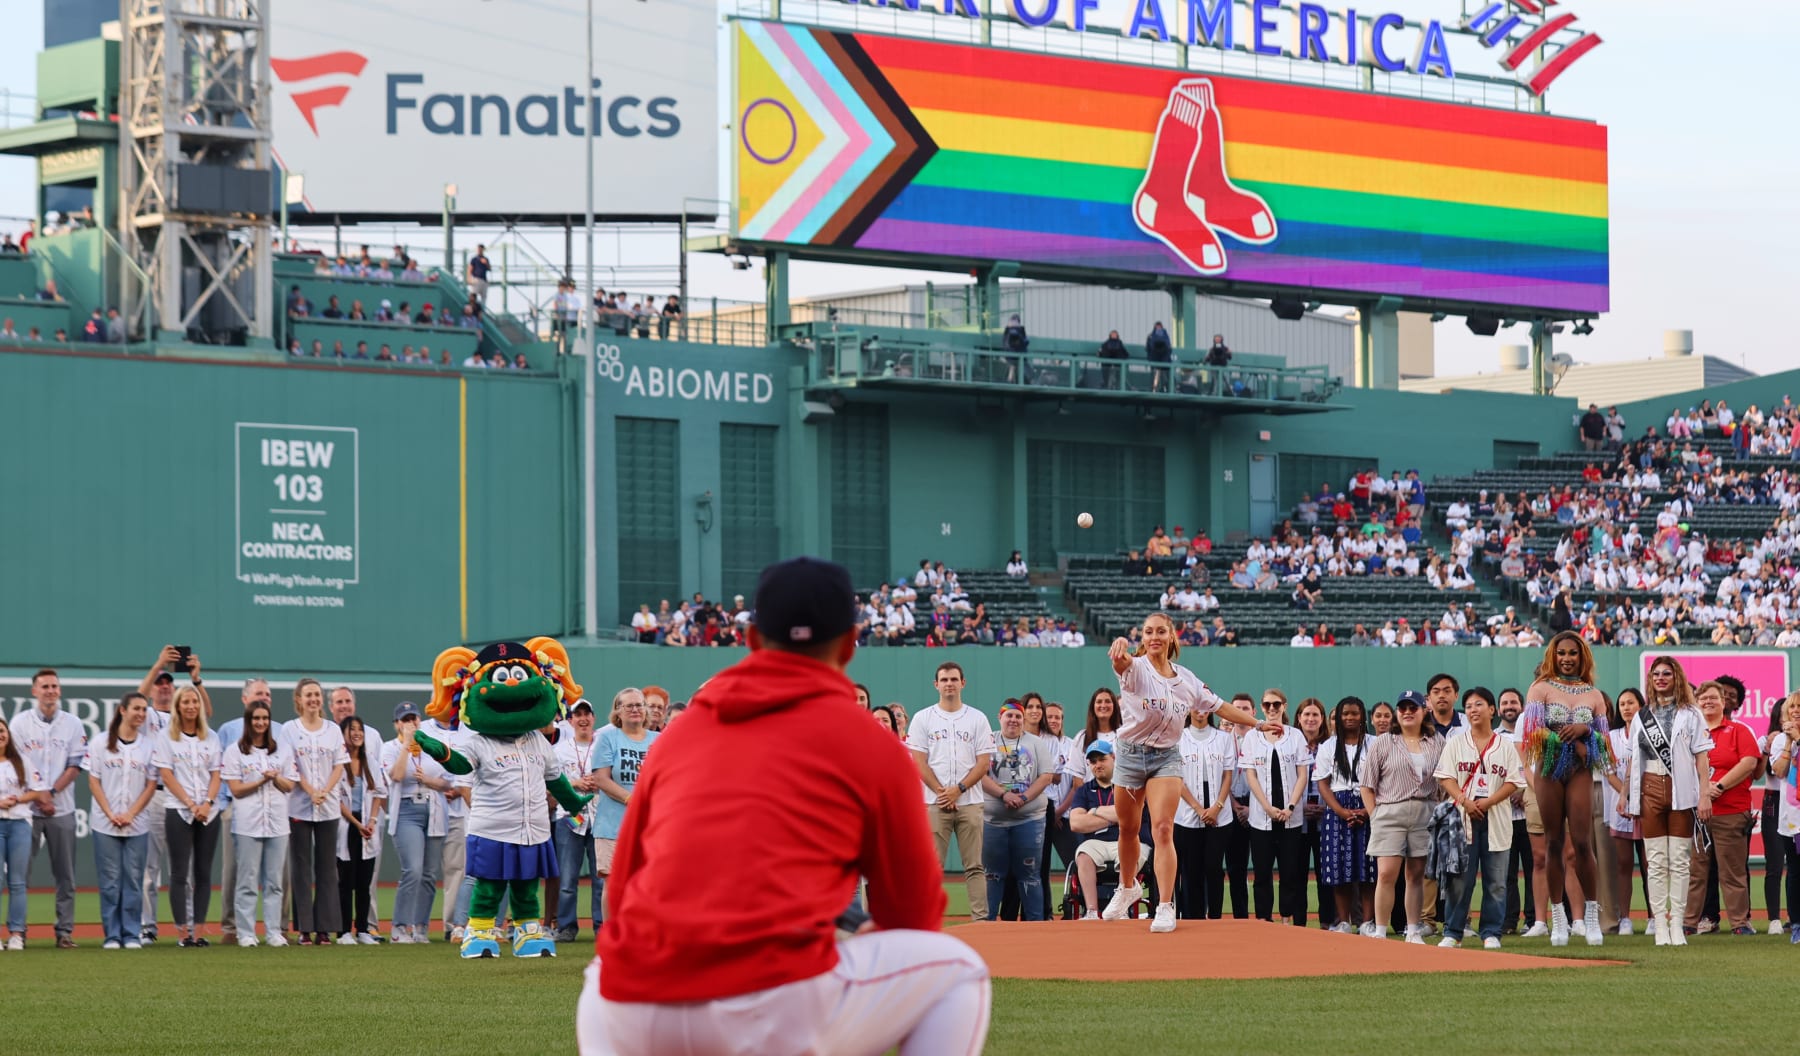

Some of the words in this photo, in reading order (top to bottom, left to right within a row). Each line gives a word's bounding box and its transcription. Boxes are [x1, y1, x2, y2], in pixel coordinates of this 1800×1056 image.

[1124, 0, 1455, 79] AMERICA
[386, 73, 682, 138] Fanatics
[625, 365, 773, 403] ABIOMED
[261, 438, 334, 468] IBEW
[273, 473, 323, 502] 103
[272, 522, 325, 541] NECA
[242, 541, 353, 561] CONTRACTORS
[253, 594, 304, 606] POWERING
[306, 596, 344, 607] BOSTON
[620, 748, 646, 760] FRE
